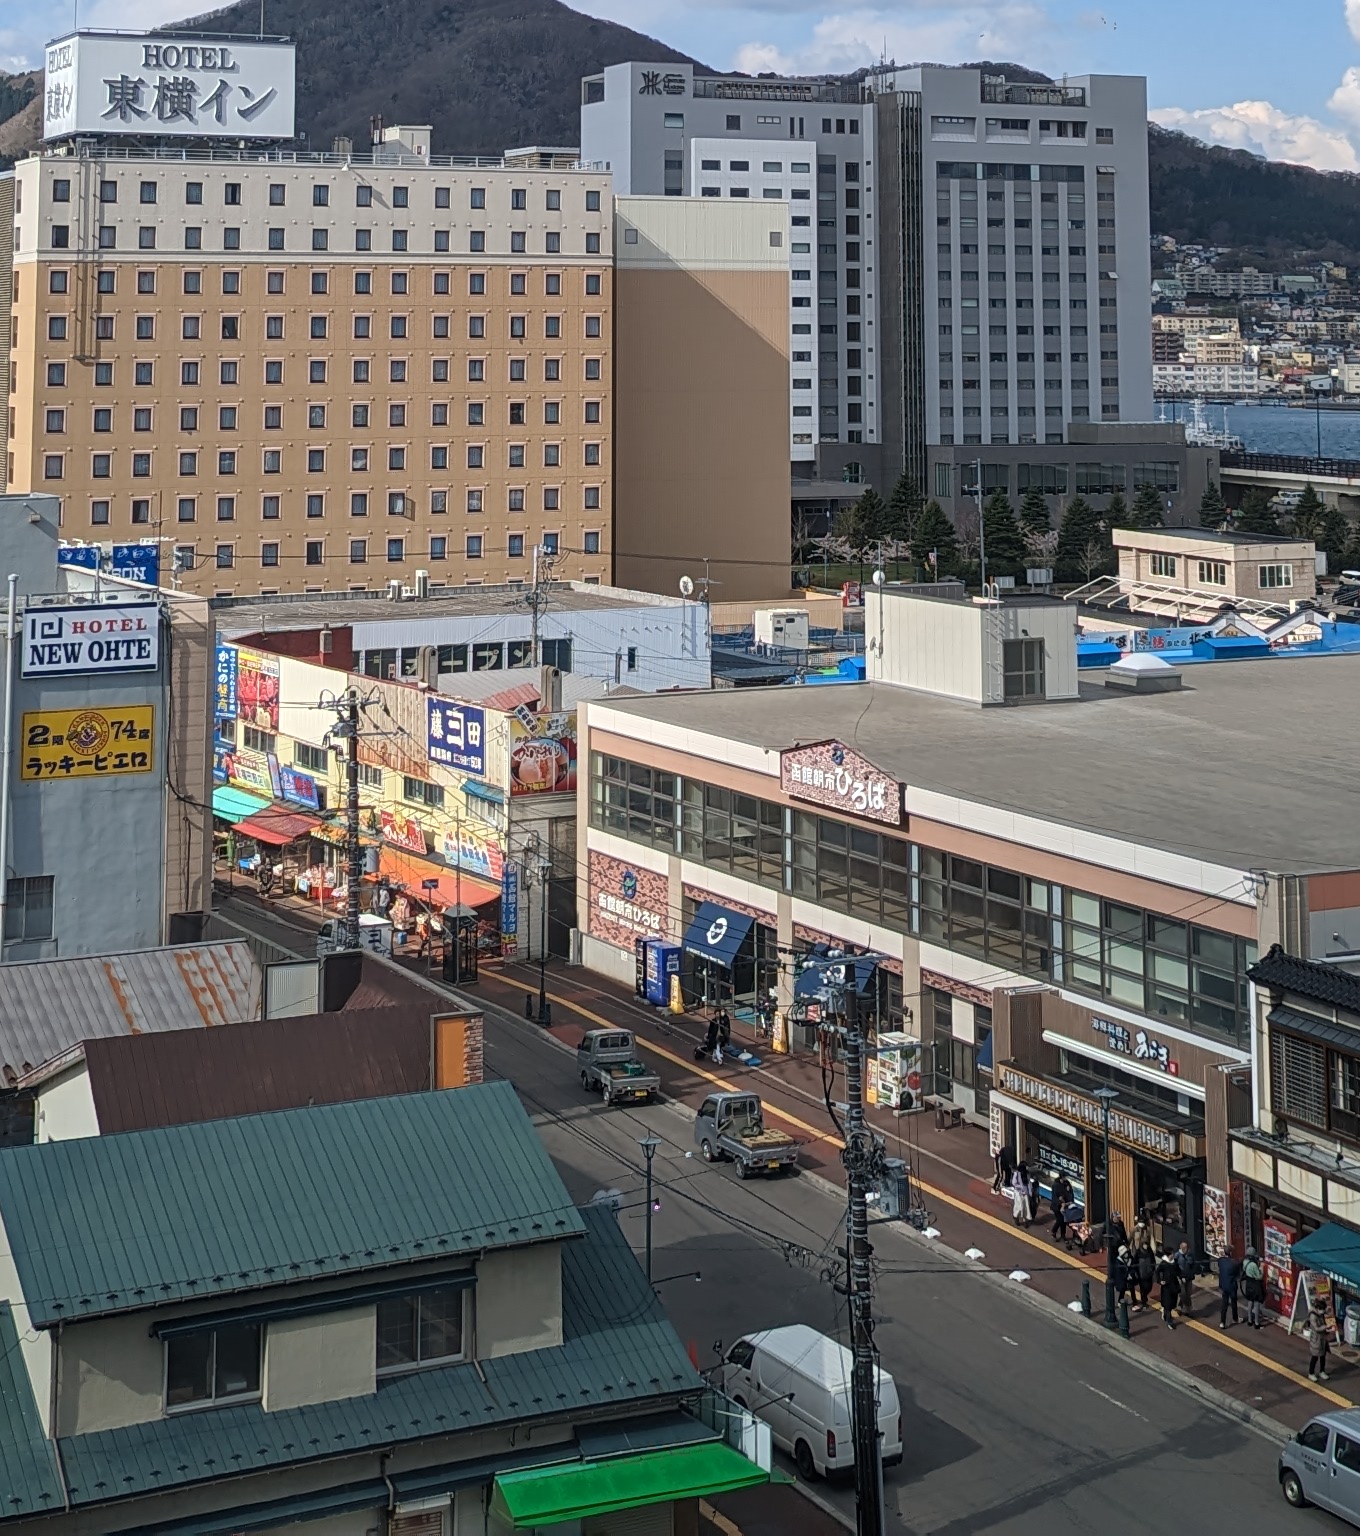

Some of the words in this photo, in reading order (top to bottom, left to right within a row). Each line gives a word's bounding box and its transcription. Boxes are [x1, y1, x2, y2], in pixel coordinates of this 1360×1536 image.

[142, 44, 237, 70] HOTEL
[101, 73, 275, 122] 東横イン
[72, 618, 147, 634] HOTEL
[29, 642, 83, 665] NEW
[88, 638, 151, 662] OHTE
[26, 751, 148, 776] ラッキーピエロ
